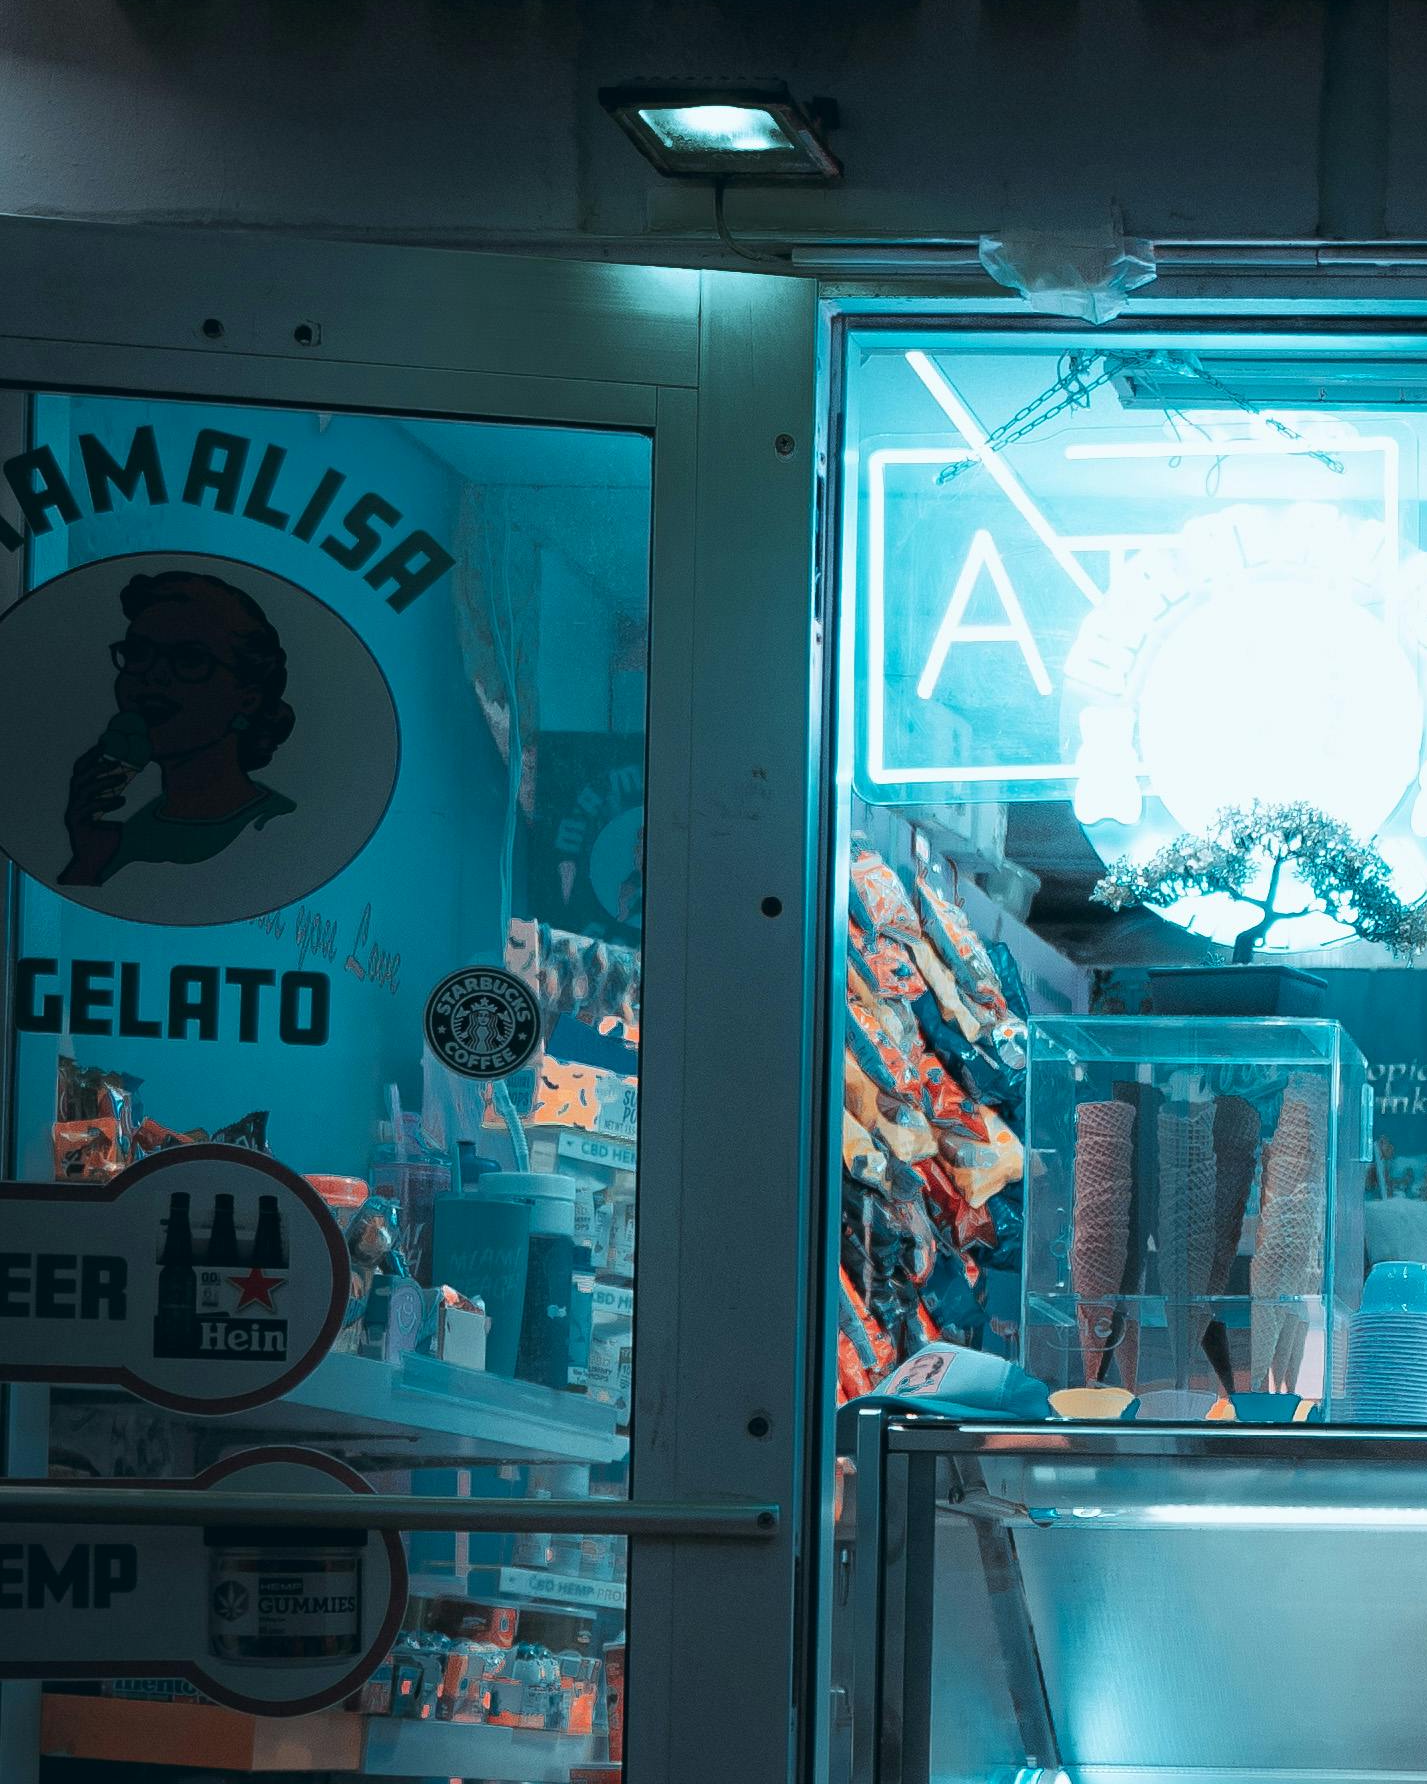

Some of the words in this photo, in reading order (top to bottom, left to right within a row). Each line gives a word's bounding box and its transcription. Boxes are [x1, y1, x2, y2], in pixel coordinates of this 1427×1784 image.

[0, 424, 457, 615] AMALISA
[15, 956, 331, 1047] GELATO
[436, 976, 531, 1024] STARBUCKS
[444, 1042, 517, 1070] COFFEE
[0, 1253, 128, 1319] EER
[0, 1543, 137, 1609] EMP
[257, 1596, 357, 1615] GUMMIES
